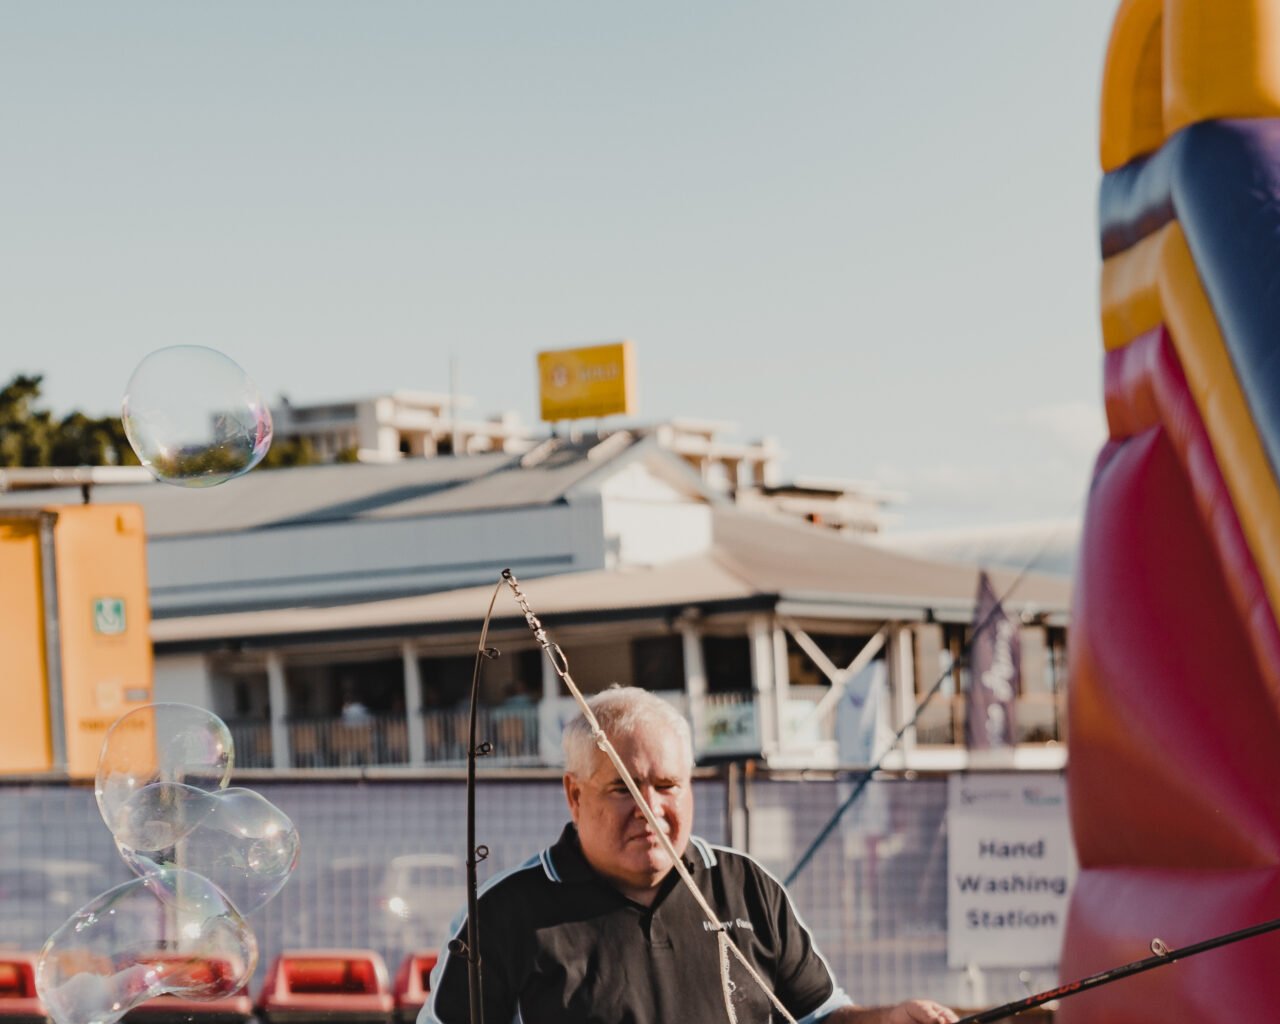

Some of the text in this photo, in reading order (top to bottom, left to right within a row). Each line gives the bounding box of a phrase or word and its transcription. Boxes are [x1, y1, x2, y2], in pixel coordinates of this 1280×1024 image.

[978, 840, 1045, 859] Hand
[957, 875, 1067, 896] Washing
[966, 909, 1057, 928] Station
